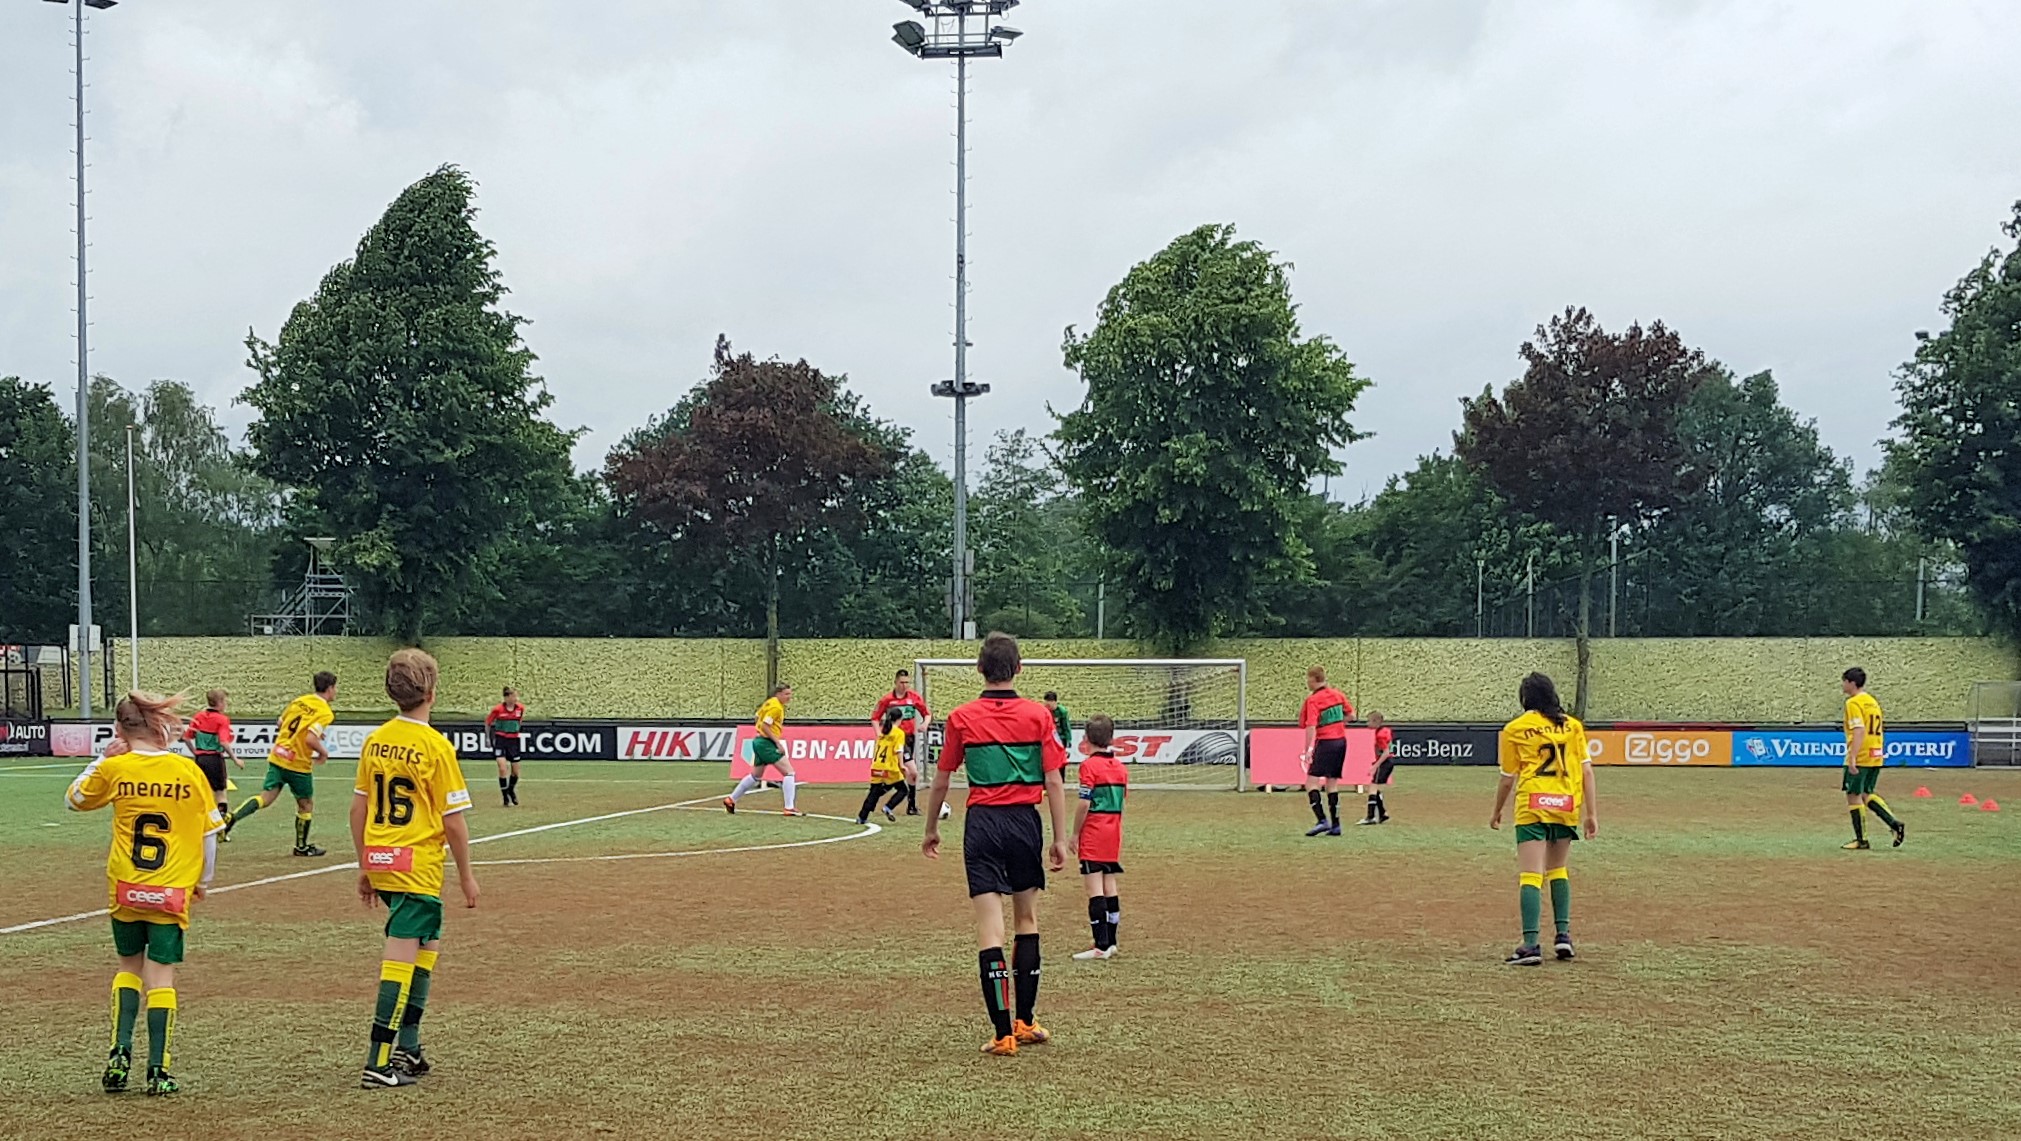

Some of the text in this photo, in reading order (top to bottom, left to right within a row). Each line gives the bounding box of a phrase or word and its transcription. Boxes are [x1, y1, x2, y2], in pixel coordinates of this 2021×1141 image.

[15, 725, 46, 740] AUTO
[1868, 714, 1881, 736] 12
[625, 730, 734, 757] HIKVI
[1390, 739, 1473, 758] des-Benz
[1535, 743, 1568, 777] 21
[118, 778, 191, 801] menzis
[373, 772, 416, 827] 16
[131, 812, 171, 873] 6
